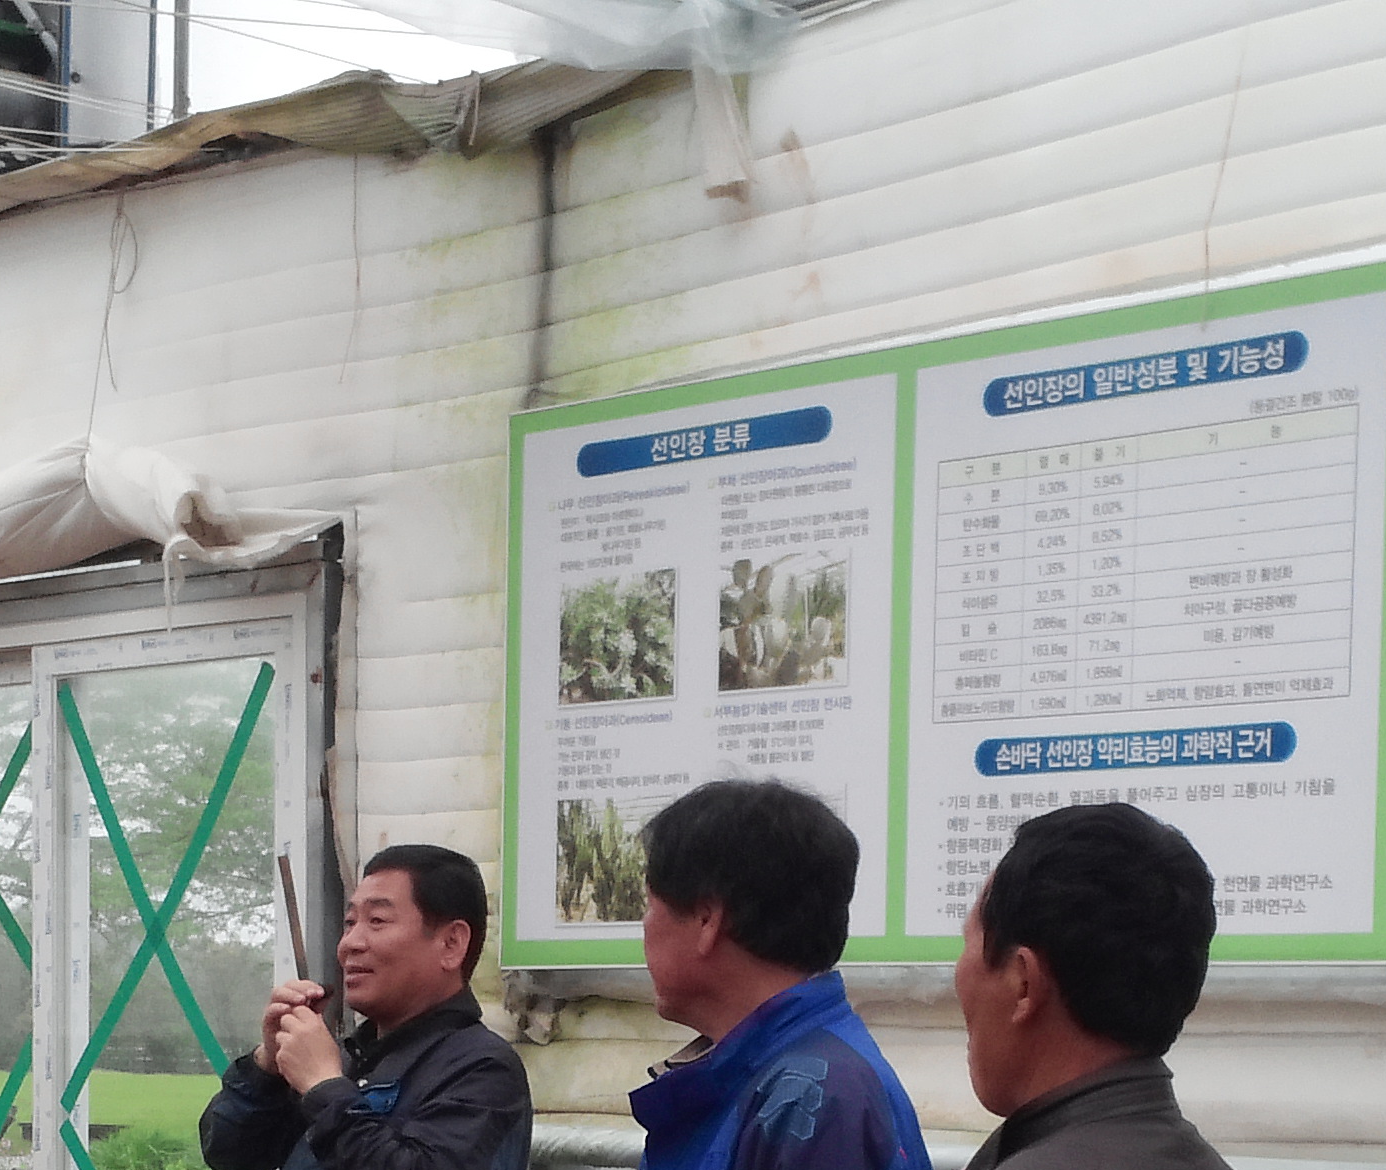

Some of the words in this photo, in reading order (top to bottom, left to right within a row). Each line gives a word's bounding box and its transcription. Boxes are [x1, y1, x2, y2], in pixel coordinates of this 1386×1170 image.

[1003, 371, 1084, 409] 선인장의
[1093, 357, 1179, 395] 일반성분
[1187, 351, 1208, 380] 및
[1217, 340, 1285, 374] 기능성
[650, 432, 706, 462] 선인장
[713, 424, 751, 450] 분류
[995, 741, 1042, 770] 손바닥
[1047, 738, 1093, 768] 선인장
[1098, 734, 1177, 764] 약리효능의
[1183, 731, 1232, 760] 과학적
[1237, 729, 1272, 757] 근거
